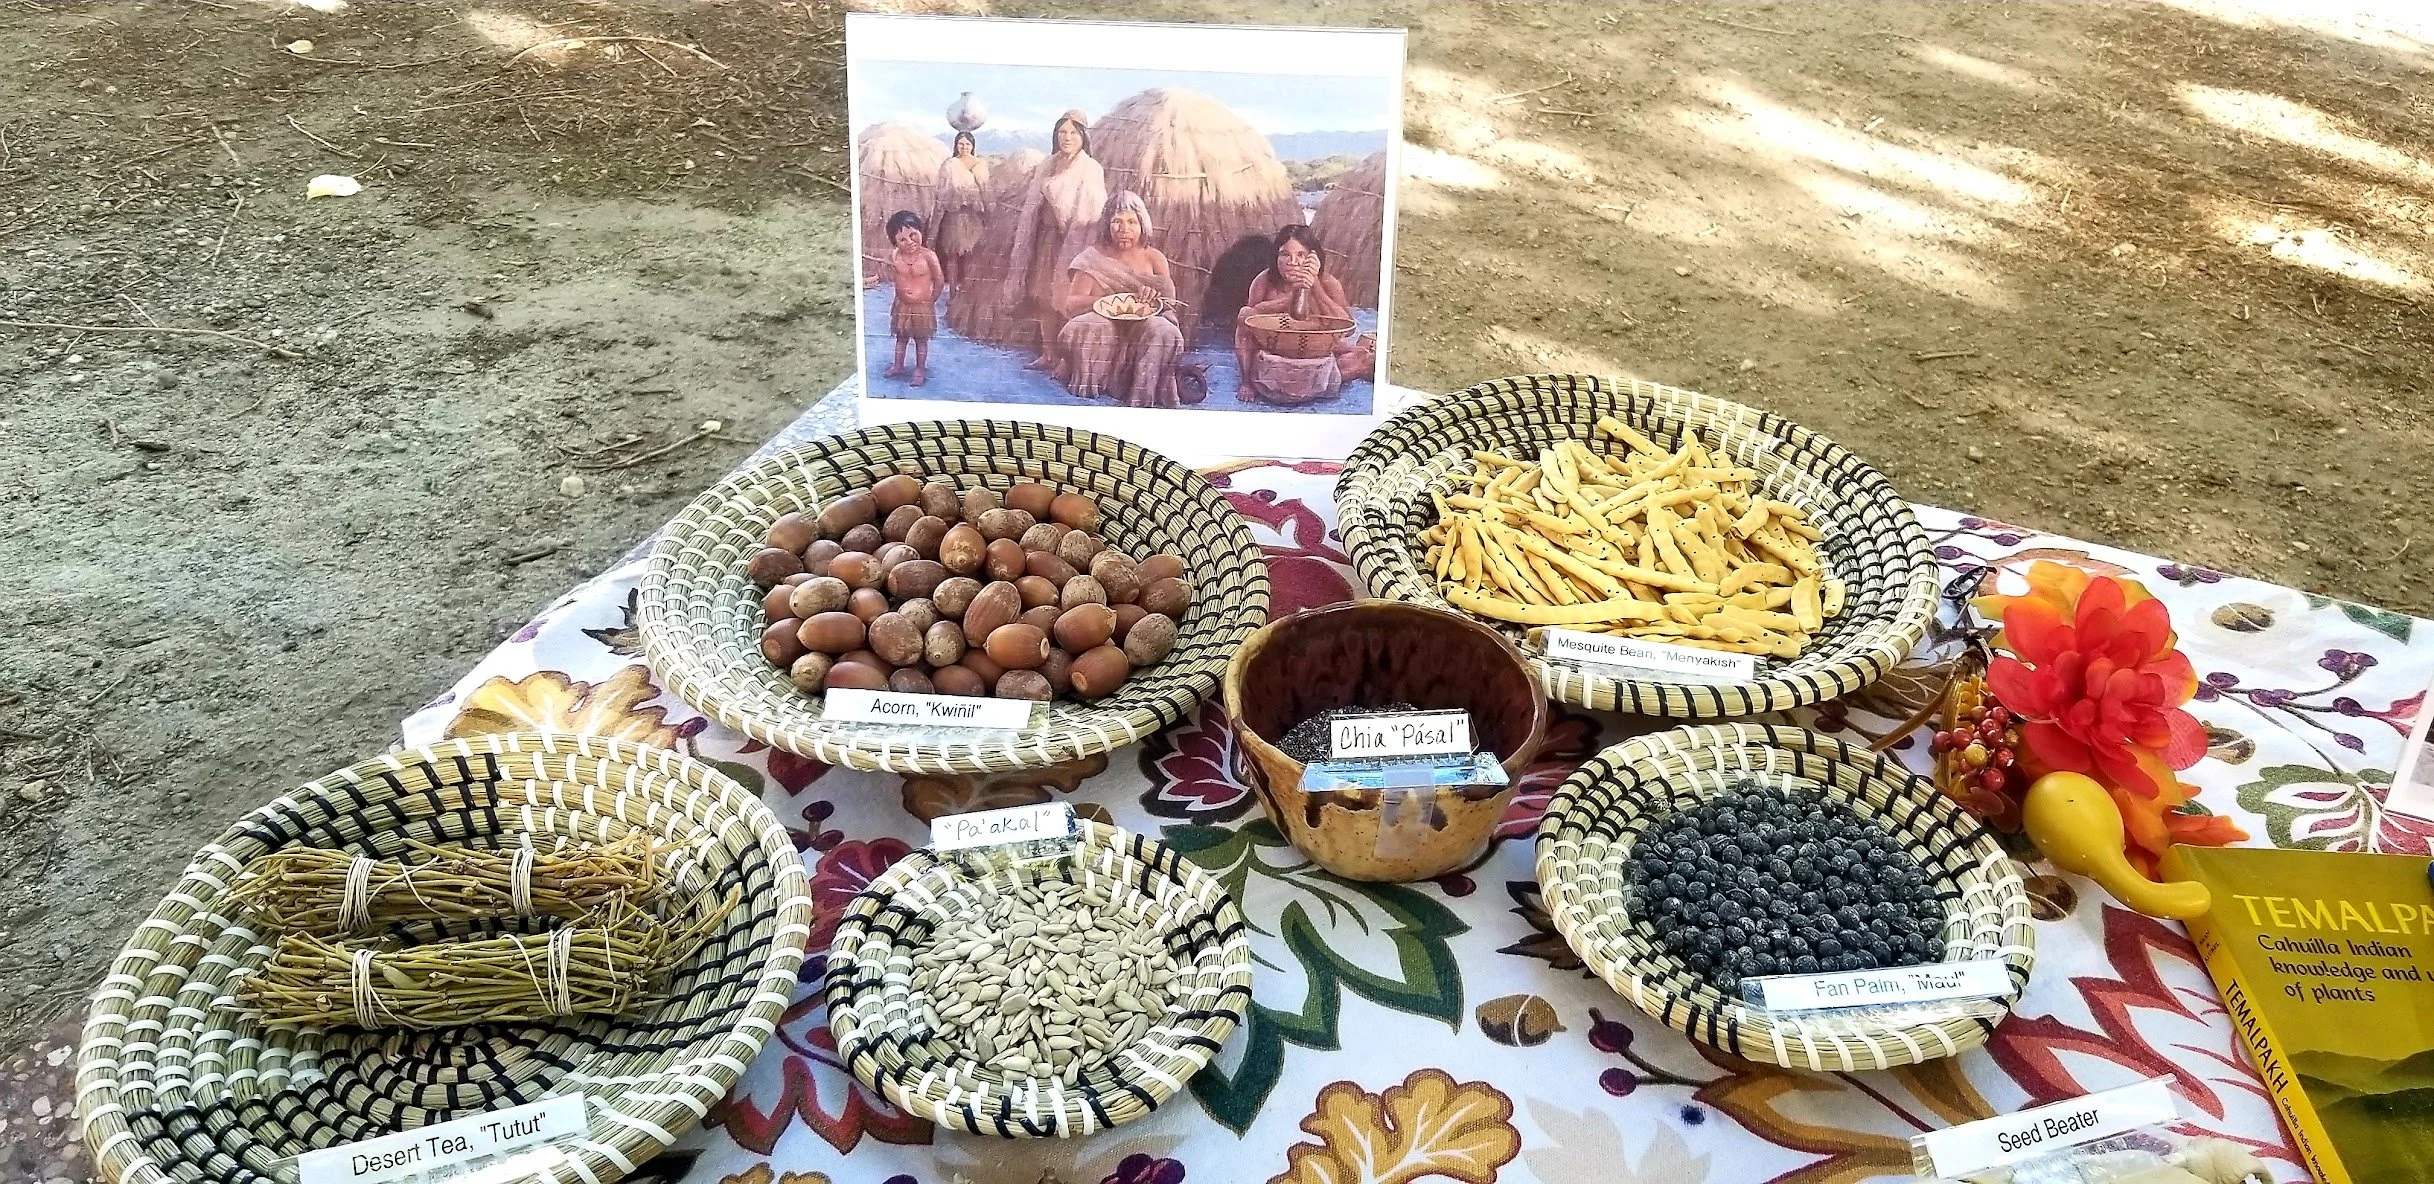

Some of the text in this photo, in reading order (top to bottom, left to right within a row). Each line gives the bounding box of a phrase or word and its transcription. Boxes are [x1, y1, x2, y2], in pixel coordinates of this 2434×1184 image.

[1557, 636, 1615, 655] Mesquite
[1619, 645, 1656, 661] Bean,
[870, 698, 919, 718] Acorn,
[1340, 726, 1387, 750] Chia
[2346, 939, 2412, 958] Indian
[2269, 956, 2377, 983] knowledge
[2382, 965, 2422, 982] and
[1814, 979, 1849, 997] Fan
[1855, 977, 1905, 996] Palm,
[2284, 981, 2376, 1005] of plants
[2225, 978, 2289, 1095] TEMALPAKH
[2298, 1129, 2312, 1155] Indian
[1997, 1108, 2099, 1153] Seed Beater
[352, 1112, 546, 1176] Desert Tea, "Tutut"
